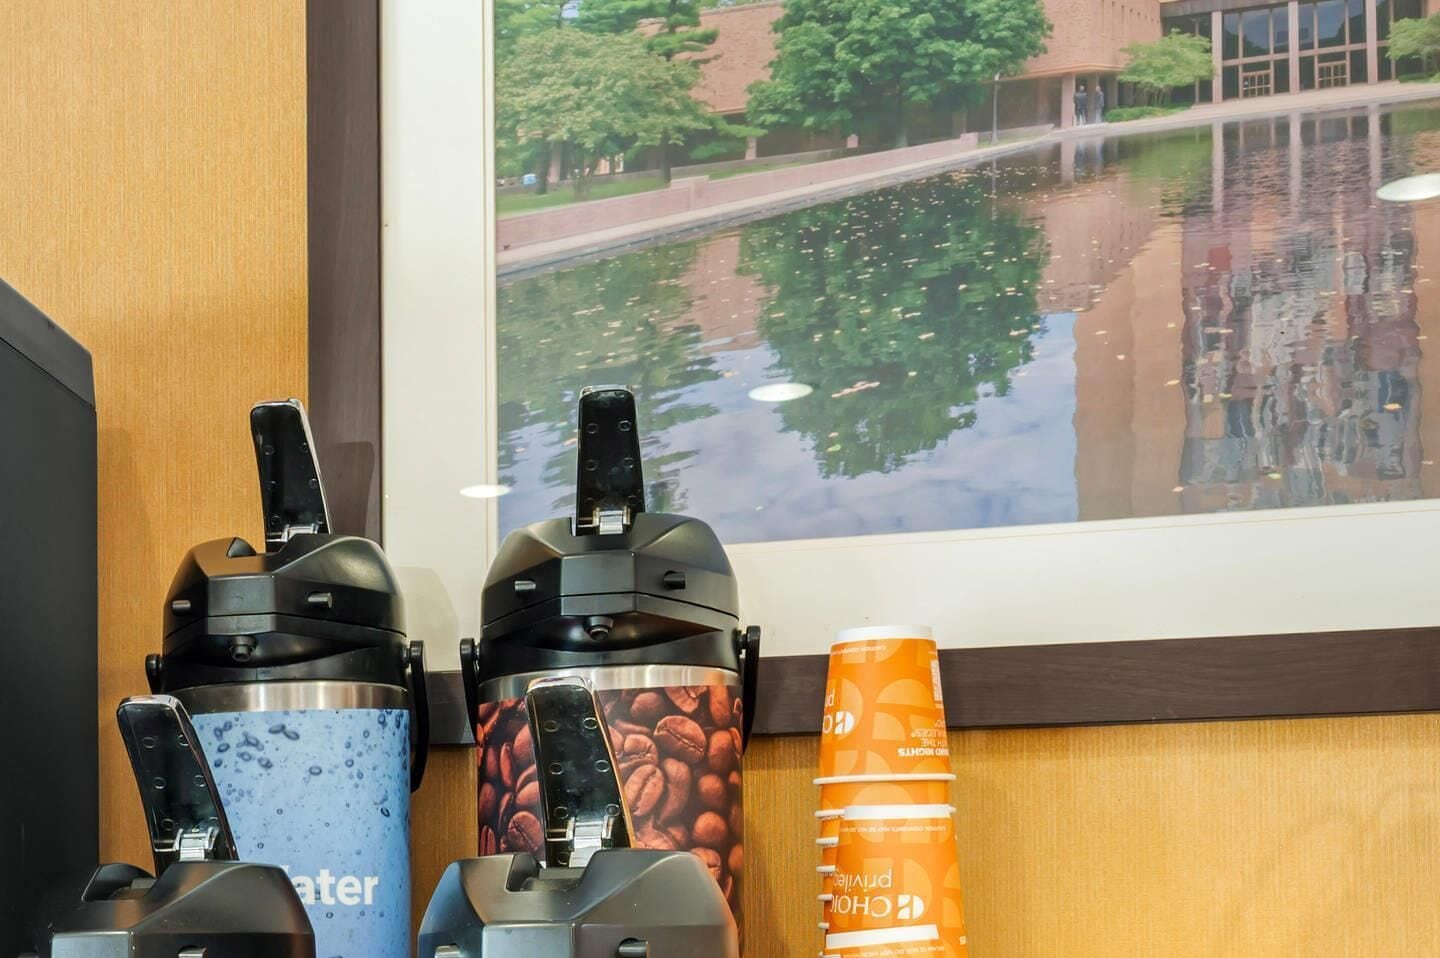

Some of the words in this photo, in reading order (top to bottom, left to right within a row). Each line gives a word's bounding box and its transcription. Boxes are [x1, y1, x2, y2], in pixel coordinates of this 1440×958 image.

[898, 747, 934, 757] NIGHTS
[835, 869, 892, 892] privile
[831, 894, 892, 917] CHOIC
